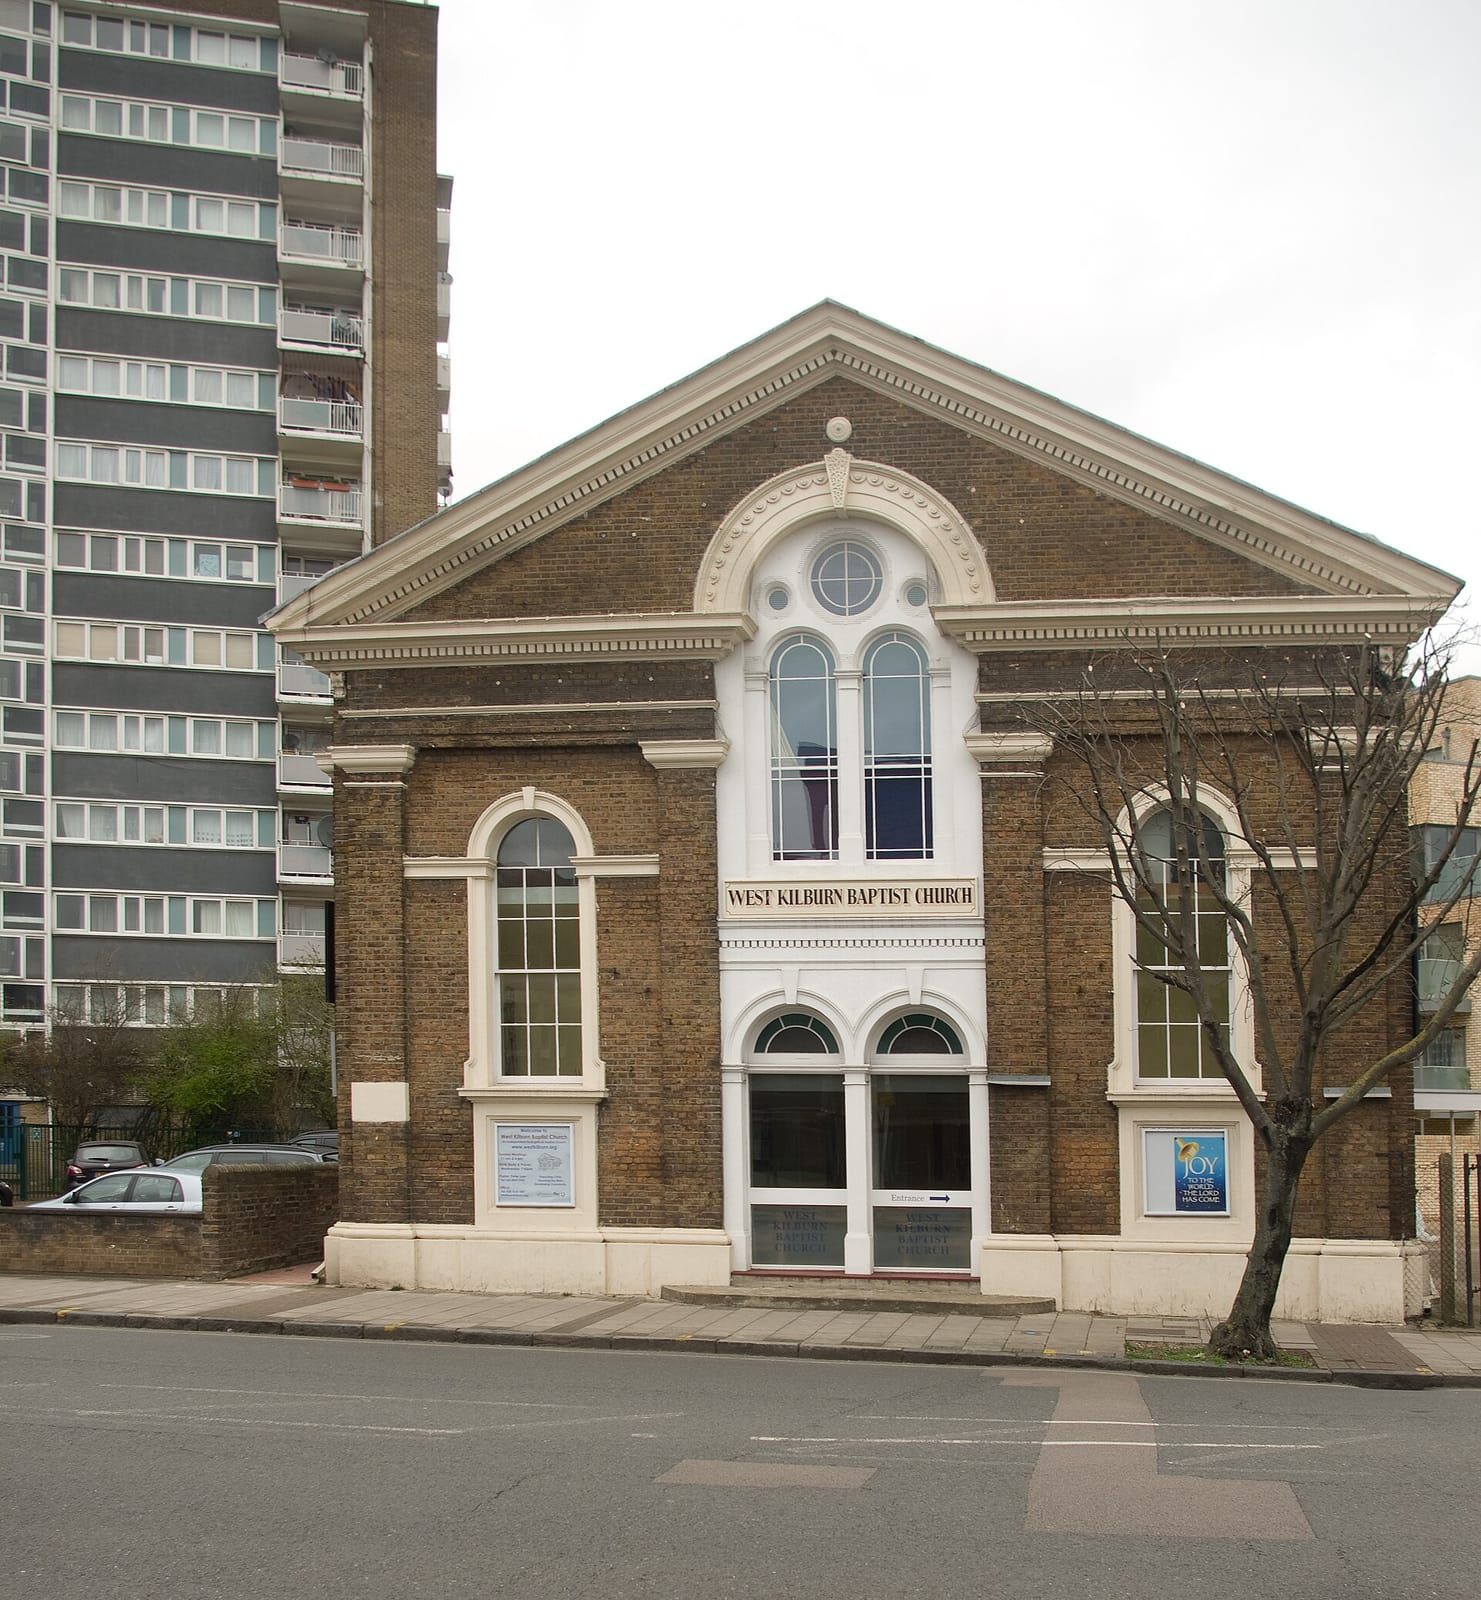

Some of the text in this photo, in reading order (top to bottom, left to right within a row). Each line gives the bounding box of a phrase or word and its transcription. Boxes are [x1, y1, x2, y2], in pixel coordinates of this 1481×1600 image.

[728, 887, 972, 906] WEST KILBURN BAPTIST CHURCH
[1183, 1156, 1219, 1179] JOY
[891, 1194, 925, 1202] Entrance
[783, 1210, 816, 1219] WEST
[906, 1213, 941, 1222] WEST
[773, 1222, 828, 1231] KILBURN
[895, 1224, 950, 1233] KILBURN
[776, 1232, 825, 1242] BAPTIST
[898, 1235, 948, 1244] BAPTIST
[775, 1243, 826, 1253] CHURCH
[897, 1246, 950, 1256] CHURCH
